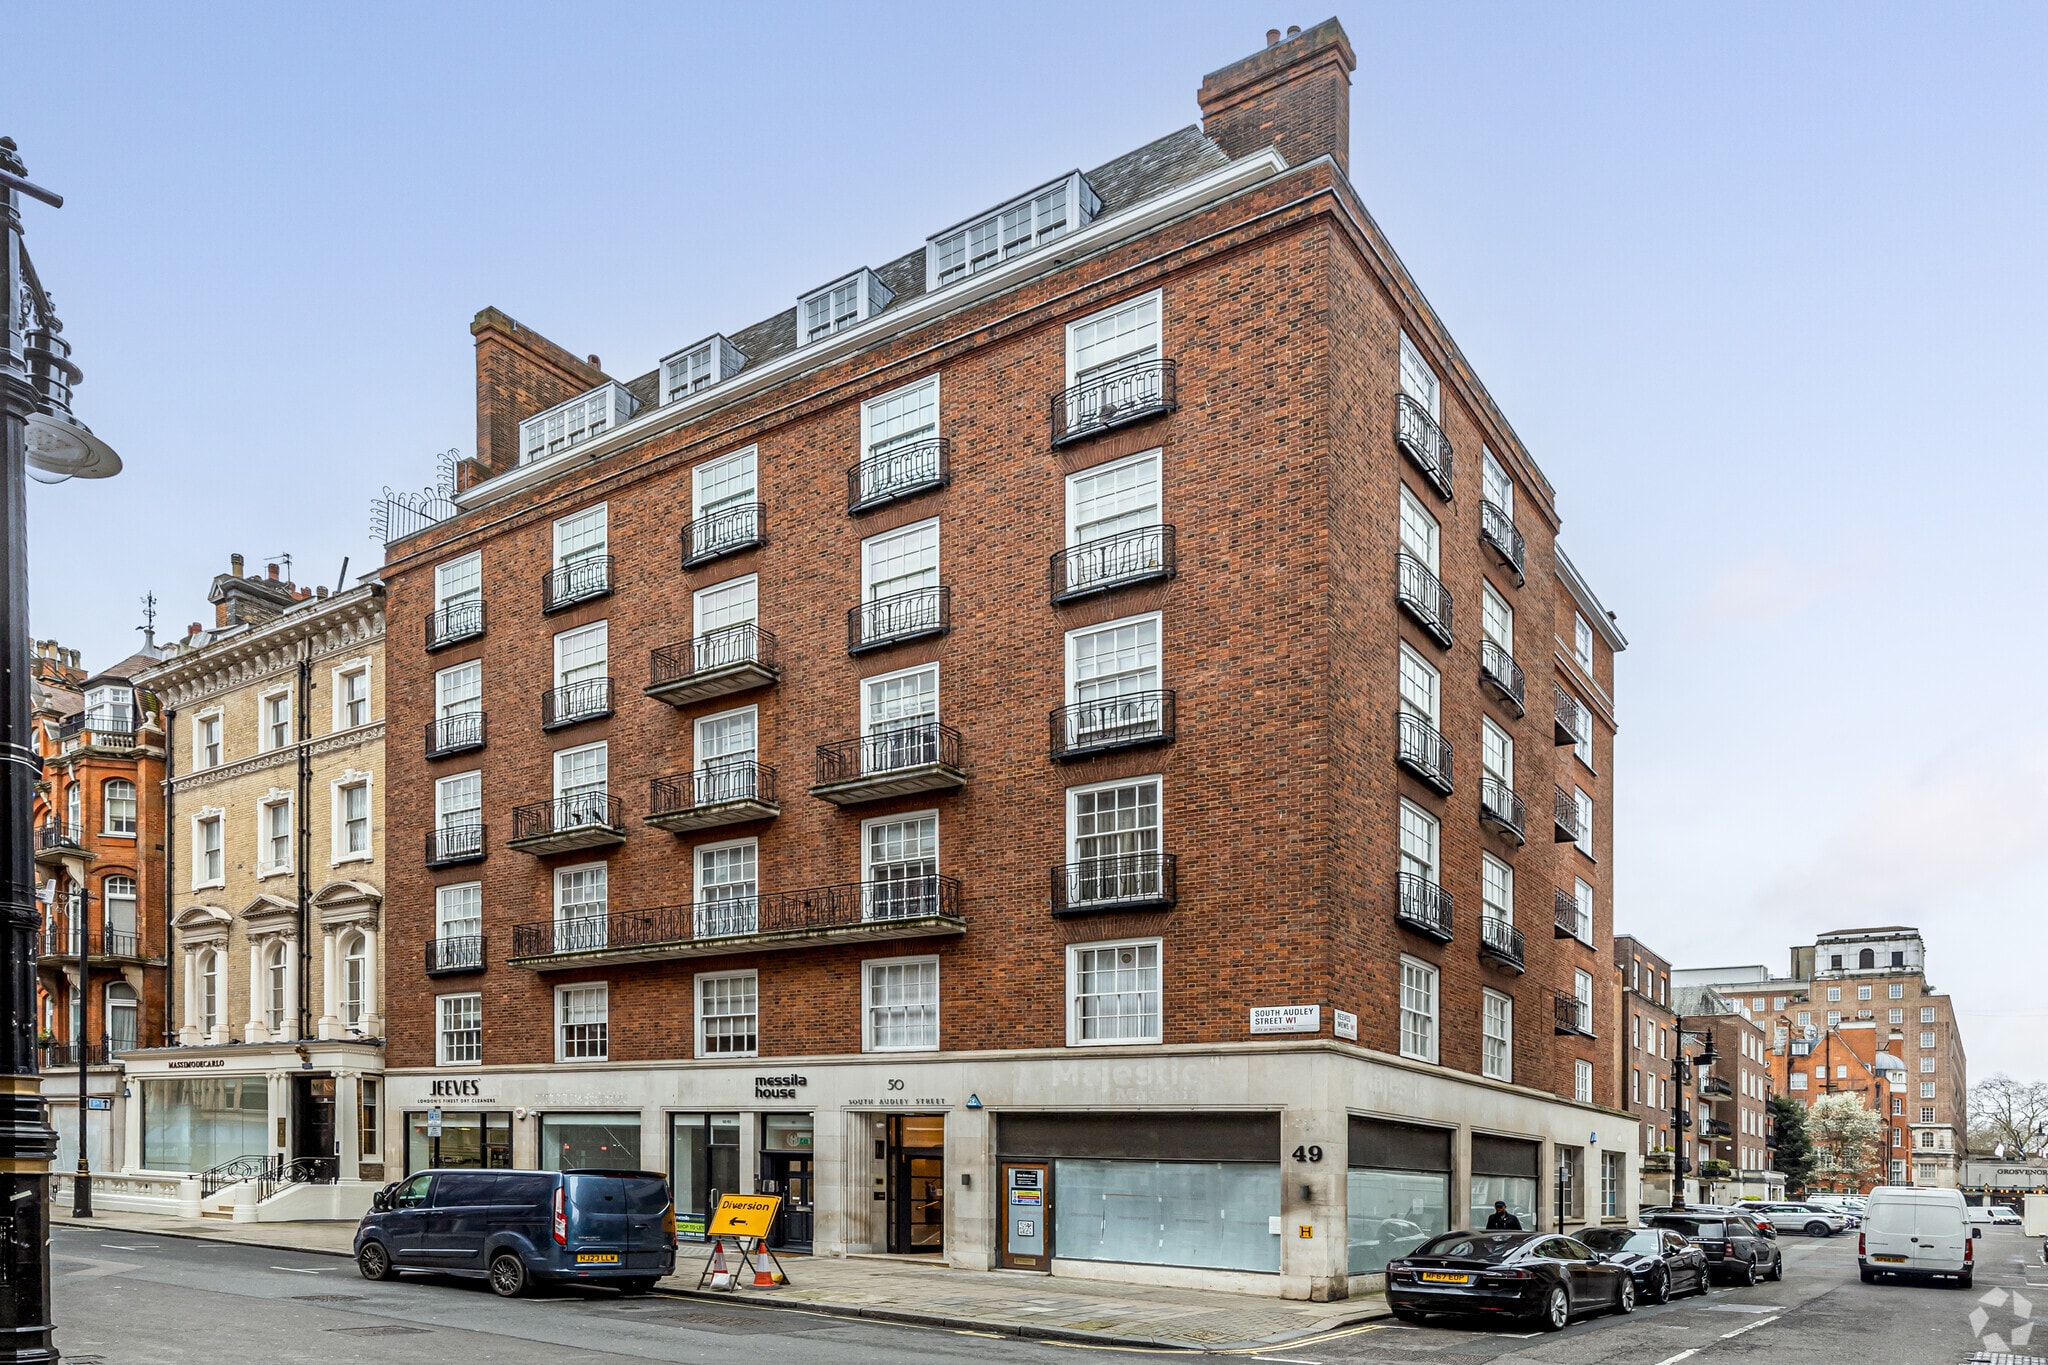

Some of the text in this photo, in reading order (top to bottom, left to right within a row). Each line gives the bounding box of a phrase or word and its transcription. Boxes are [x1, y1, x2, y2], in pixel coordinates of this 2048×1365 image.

[1255, 1007, 1314, 1017] SOUTH AUDLEY
[1255, 1017, 1282, 1025] STREET
[168, 1059, 225, 1069] MASSIMODECARLO
[755, 1073, 808, 1087] messila
[887, 1079, 905, 1091] 50
[755, 1086, 796, 1099] house
[1292, 1145, 1323, 1162] 49
[1997, 1168, 2048, 1176] GROSVENOR
[722, 1200, 770, 1211] Diversion
[1301, 1226, 1311, 1237] H
